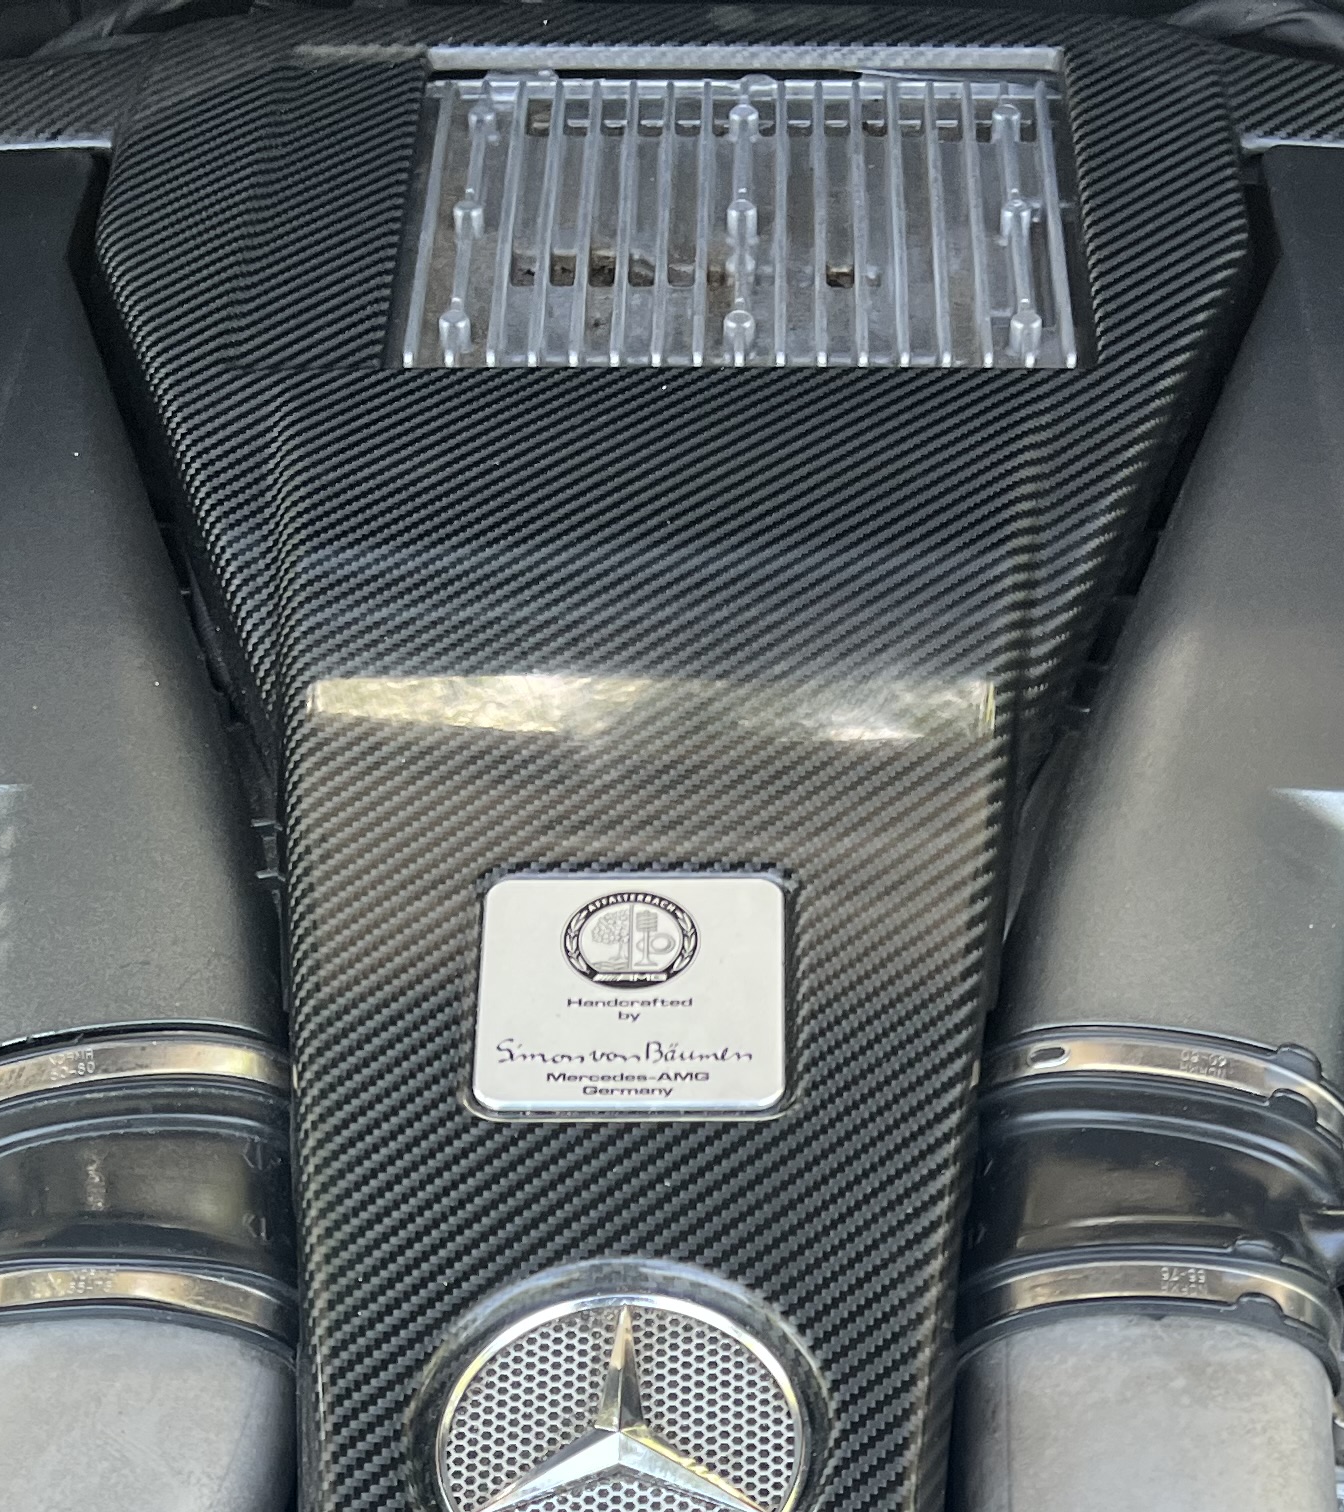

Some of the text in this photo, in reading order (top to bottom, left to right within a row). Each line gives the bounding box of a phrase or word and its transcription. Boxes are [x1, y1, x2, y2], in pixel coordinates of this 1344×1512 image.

[587, 893, 676, 913] AFFALTERBACH
[567, 998, 693, 1008] Handcrafted
[618, 1011, 640, 1022] by
[496, 1038, 585, 1064] Simon
[546, 1072, 710, 1082] Mercedes-AMG
[582, 1086, 674, 1097] Germany
